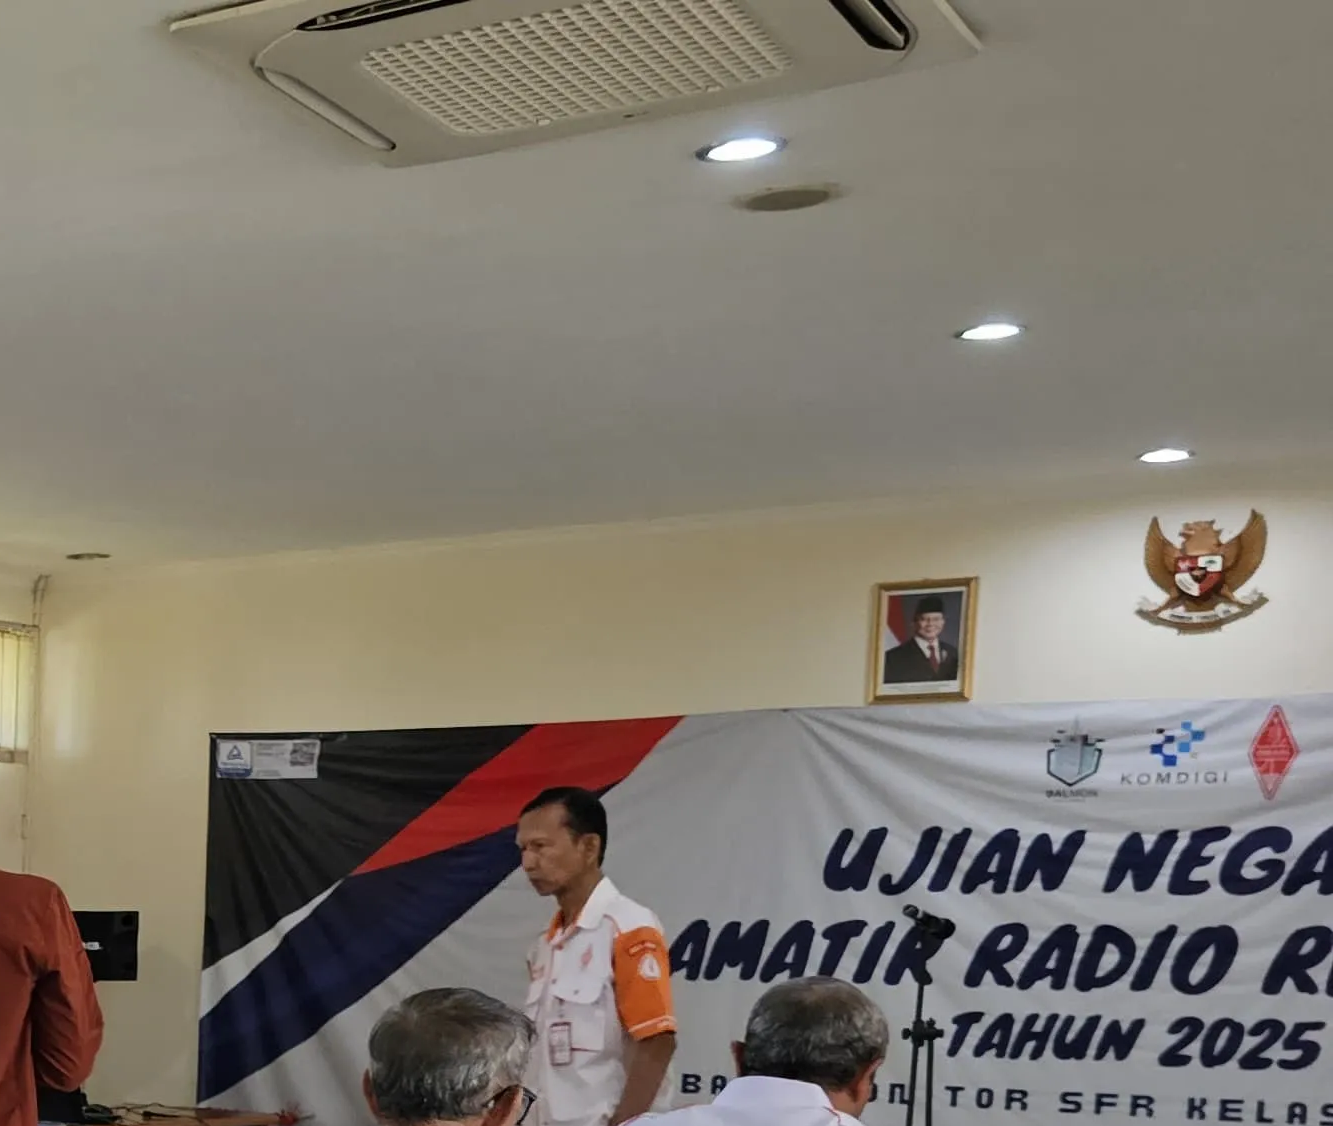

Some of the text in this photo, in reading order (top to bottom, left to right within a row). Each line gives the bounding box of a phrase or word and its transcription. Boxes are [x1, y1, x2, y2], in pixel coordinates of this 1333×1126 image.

[1120, 771, 1228, 787] KOMDIGI
[822, 825, 1333, 896] UJIAN NEGA
[668, 918, 1333, 998] AMATIR RADIO R
[946, 1011, 1327, 1070] TAHUN 2025
[1058, 1091, 1156, 1118] SFR
[1186, 1097, 1333, 1126] KELAS
